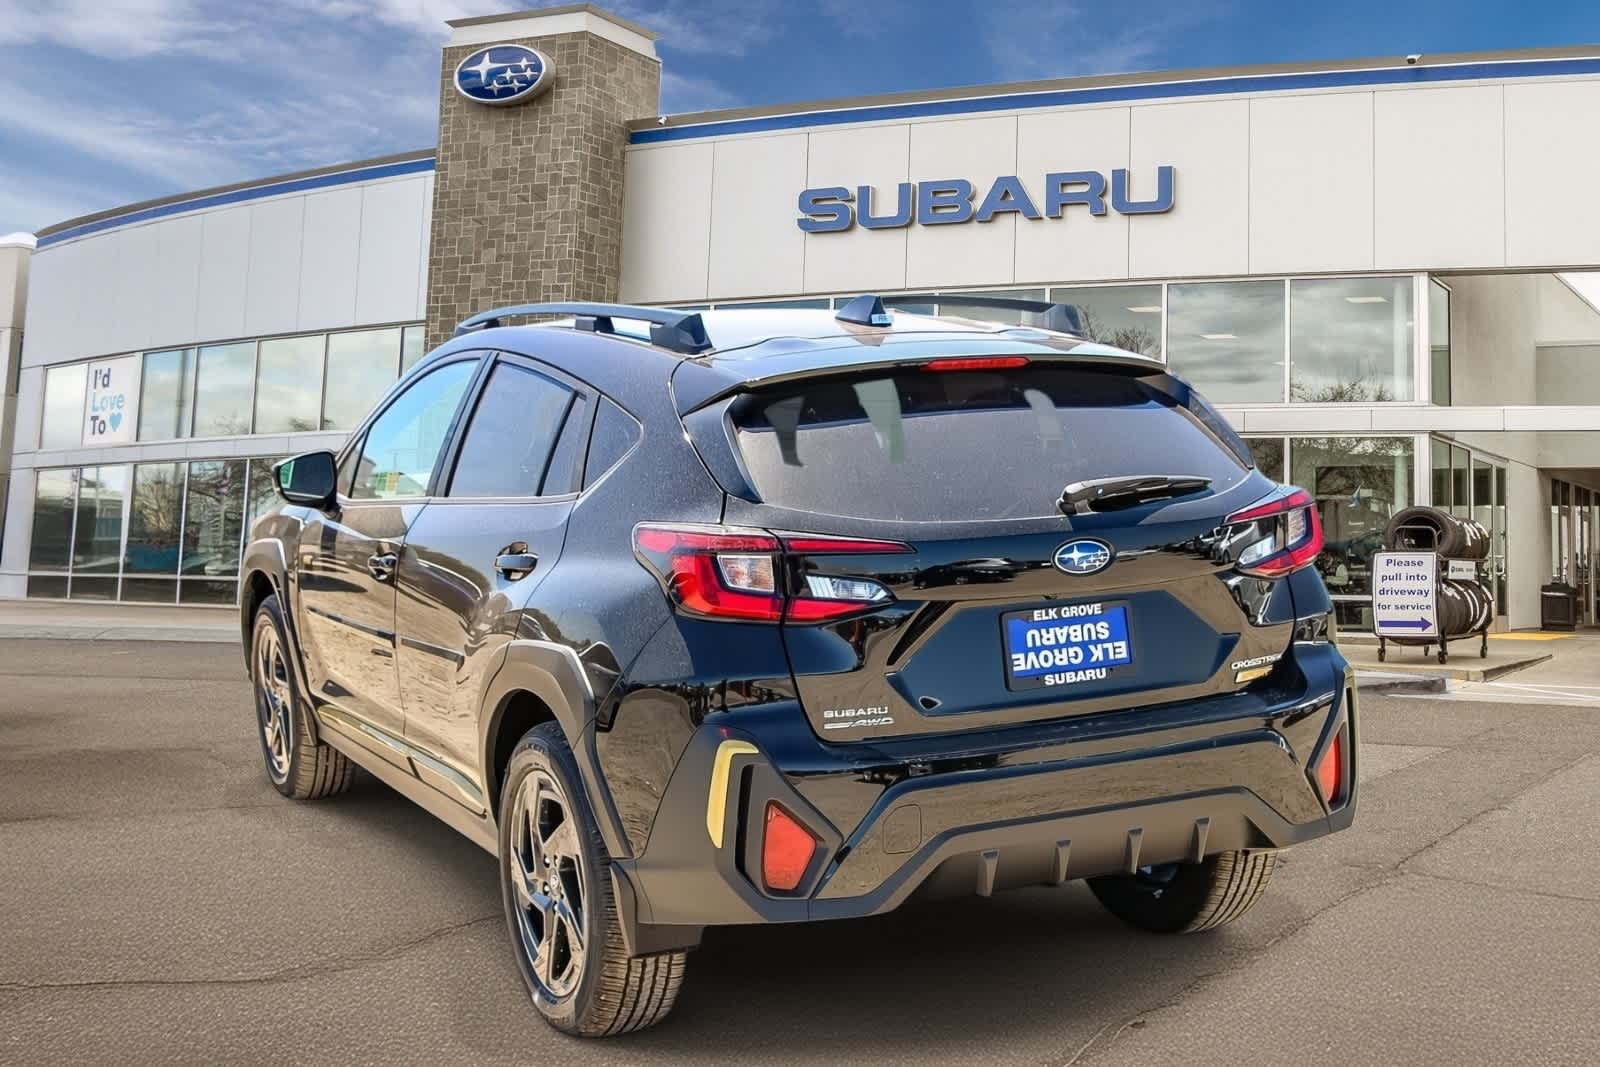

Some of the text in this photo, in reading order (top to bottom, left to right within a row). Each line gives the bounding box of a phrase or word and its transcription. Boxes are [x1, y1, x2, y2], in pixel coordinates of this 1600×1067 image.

[796, 165, 1177, 233] SUBARU
[94, 368, 111, 389] I'd
[92, 392, 124, 412] Love
[91, 416, 105, 435] To
[1386, 559, 1424, 567] Please
[1381, 573, 1428, 583] pull into
[1378, 587, 1430, 598] driveway
[1033, 603, 1102, 621] ELK GROVE
[1377, 603, 1432, 611] for service
[1026, 622, 1109, 648] SUBARU
[1011, 641, 1128, 671] ELK GROVE
[1044, 668, 1106, 685] SUBARU
[823, 706, 888, 718] SUBARU
[852, 717, 894, 727] AWD
